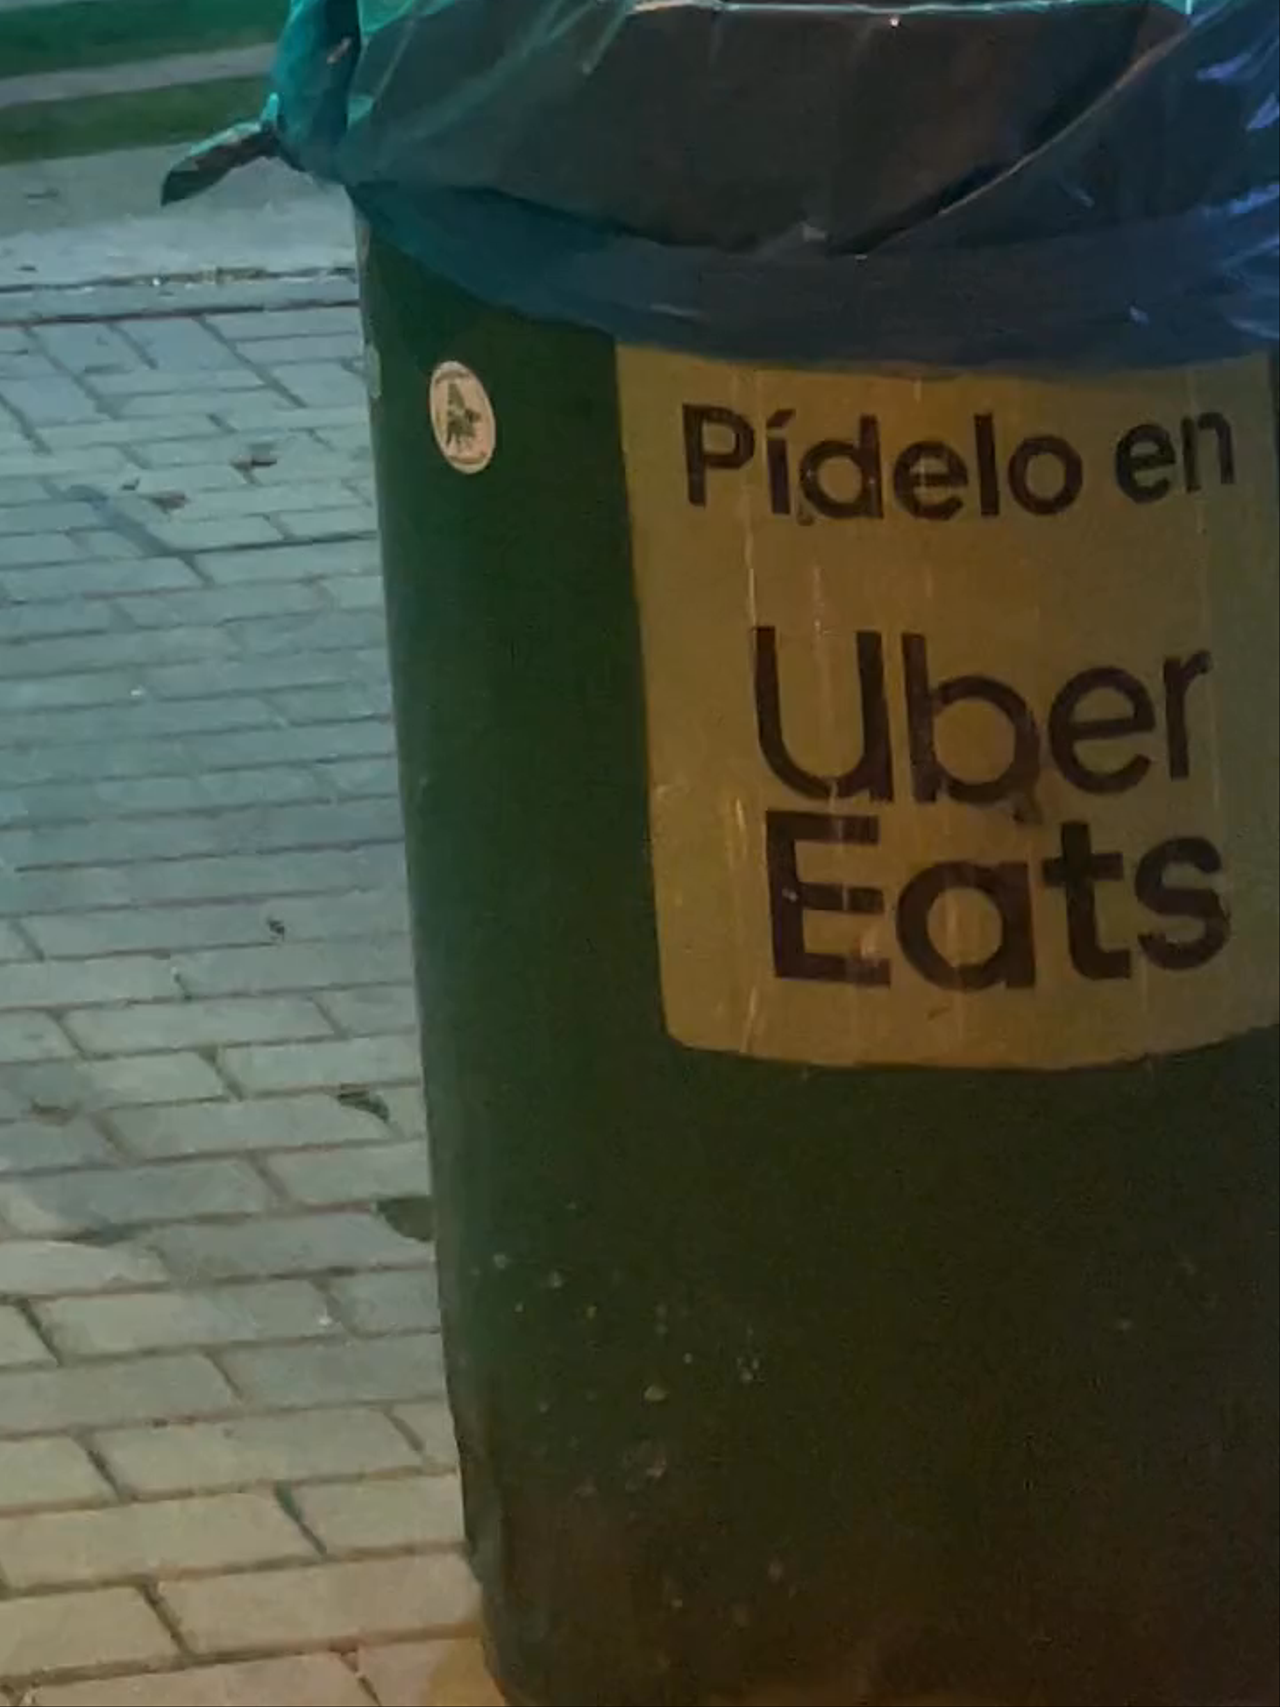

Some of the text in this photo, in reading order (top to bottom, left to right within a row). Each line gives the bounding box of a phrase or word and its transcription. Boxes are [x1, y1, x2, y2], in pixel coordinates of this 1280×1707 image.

[682, 403, 1236, 521] Pídelo en
[752, 626, 1212, 804] Uber
[766, 810, 1230, 990] Eats
